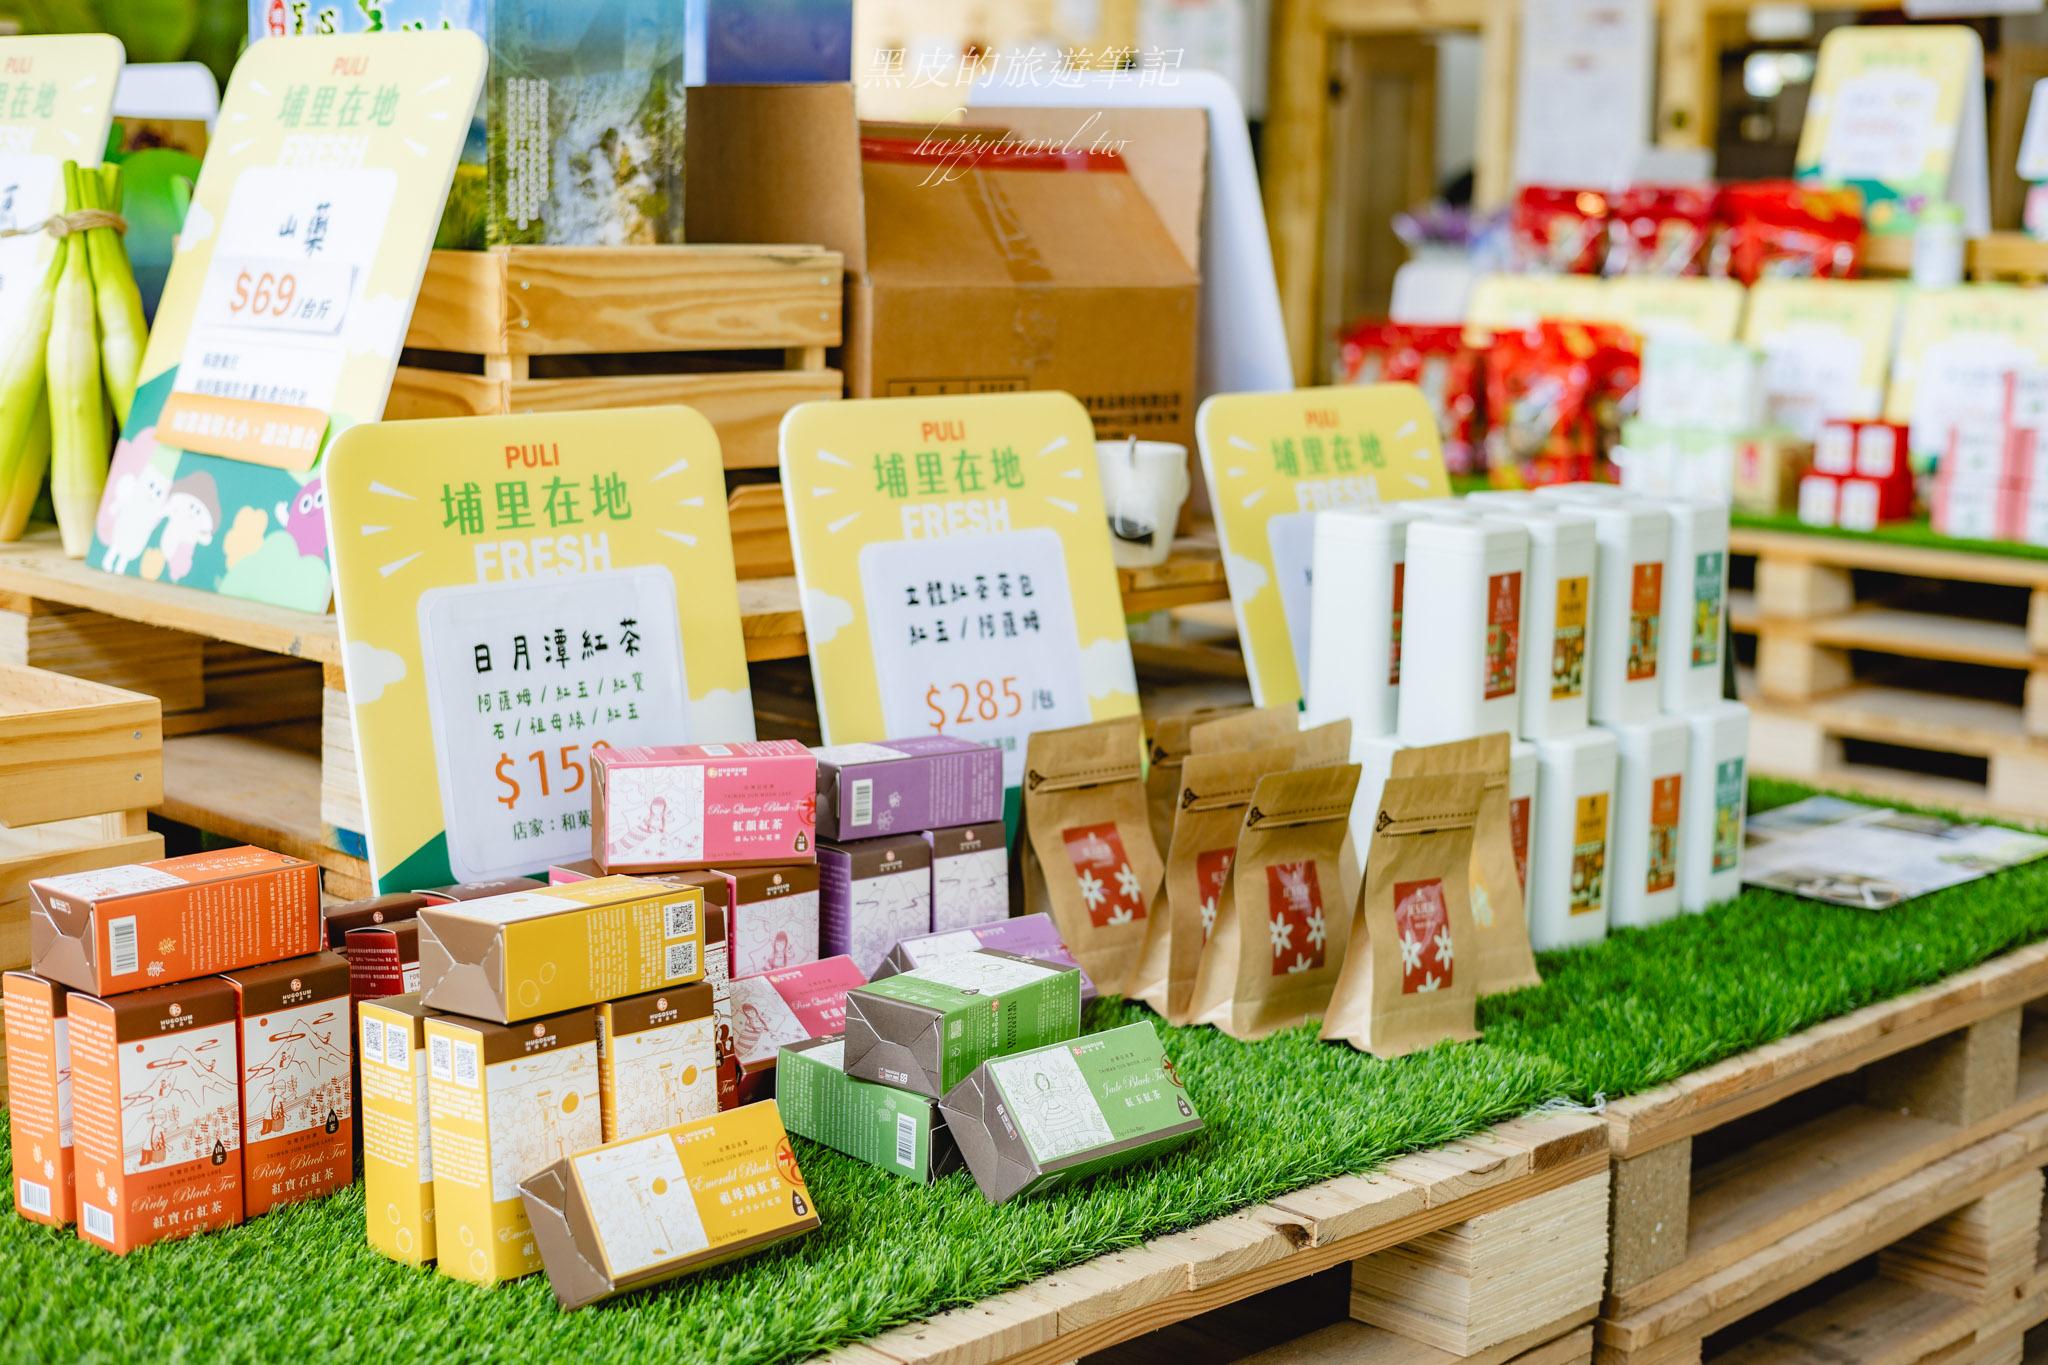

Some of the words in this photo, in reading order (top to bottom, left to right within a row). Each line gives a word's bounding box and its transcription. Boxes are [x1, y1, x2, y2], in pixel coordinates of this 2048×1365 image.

[332, 56, 370, 76] PULI
[277, 82, 400, 128] 埔里在地
[921, 420, 966, 443] PULI
[1304, 409, 1340, 430] PULI
[505, 443, 560, 469] PULI
[1270, 431, 1388, 479] 埔里在地
[873, 445, 1025, 499] 埔里在地
[440, 471, 632, 536] 埔里在地
[902, 497, 1012, 544] FRESH
[473, 531, 613, 584] FRESH
[474, 618, 641, 673] 日月潭紅茶
[926, 675, 1023, 736] $285
[495, 740, 612, 810] $15
[282, 989, 312, 1000] HUGOSUM
[160, 1014, 193, 1026] HUGOSUM
[650, 1009, 677, 1019] HUGOSUM
[525, 1035, 556, 1046] HUGOSUM
[721, 1080, 735, 1095] Tea
[1101, 1081, 1122, 1099] Jade
[1122, 1073, 1150, 1089] Black
[252, 1162, 286, 1180] Ruby
[290, 1151, 324, 1171] Black
[327, 1143, 346, 1160] Tea
[690, 1168, 737, 1192] Emerald
[738, 1159, 771, 1178] Black
[131, 1196, 168, 1214] Ruby
[173, 1183, 212, 1203] Black
[214, 1175, 236, 1193] Tea
[271, 1167, 334, 1195] 紅寶石紅茶
[153, 1201, 222, 1230] 紅寶石紅茶
